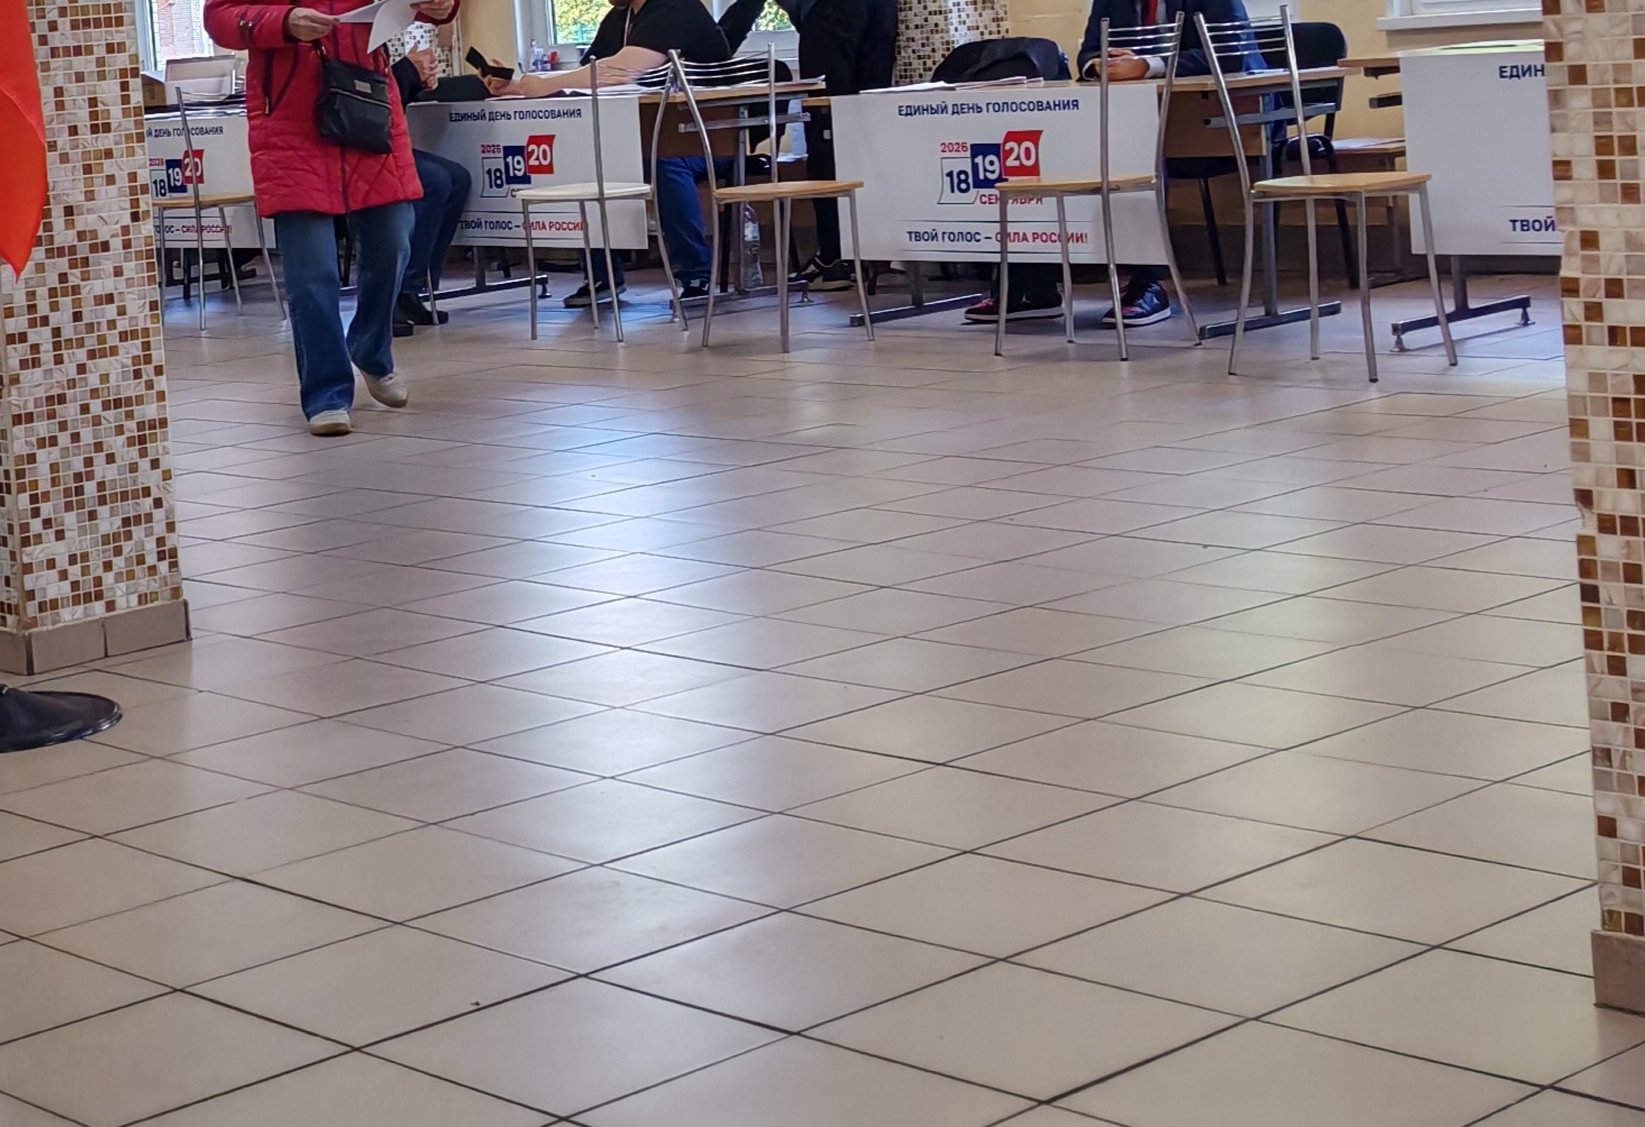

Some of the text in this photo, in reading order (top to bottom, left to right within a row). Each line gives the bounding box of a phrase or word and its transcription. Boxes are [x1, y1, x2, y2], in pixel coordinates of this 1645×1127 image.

[449, 108, 582, 123] ЕДИНЫЙ ДЕНЬ ГОЛОСОВАНИЯ
[898, 99, 1080, 118] ЕДИНЫЙ ДЕНЬ ГОЛОСОВАНИЯ
[527, 144, 551, 166] 20
[940, 142, 969, 153] 2026
[1004, 140, 1037, 167] 20
[184, 157, 202, 177] 20
[506, 155, 526, 177] 19
[973, 154, 1000, 181] 19
[167, 167, 183, 187] 19
[485, 167, 504, 189] 18
[945, 169, 971, 194] 18
[152, 178, 167, 198] 18
[459, 218, 483, 230] ТВОЙ
[484, 220, 513, 231] ГОЛОС
[1508, 215, 1556, 232] ТВОЙ
[906, 228, 939, 242] ТВОЙ
[941, 231, 982, 243] ГОЛОС
